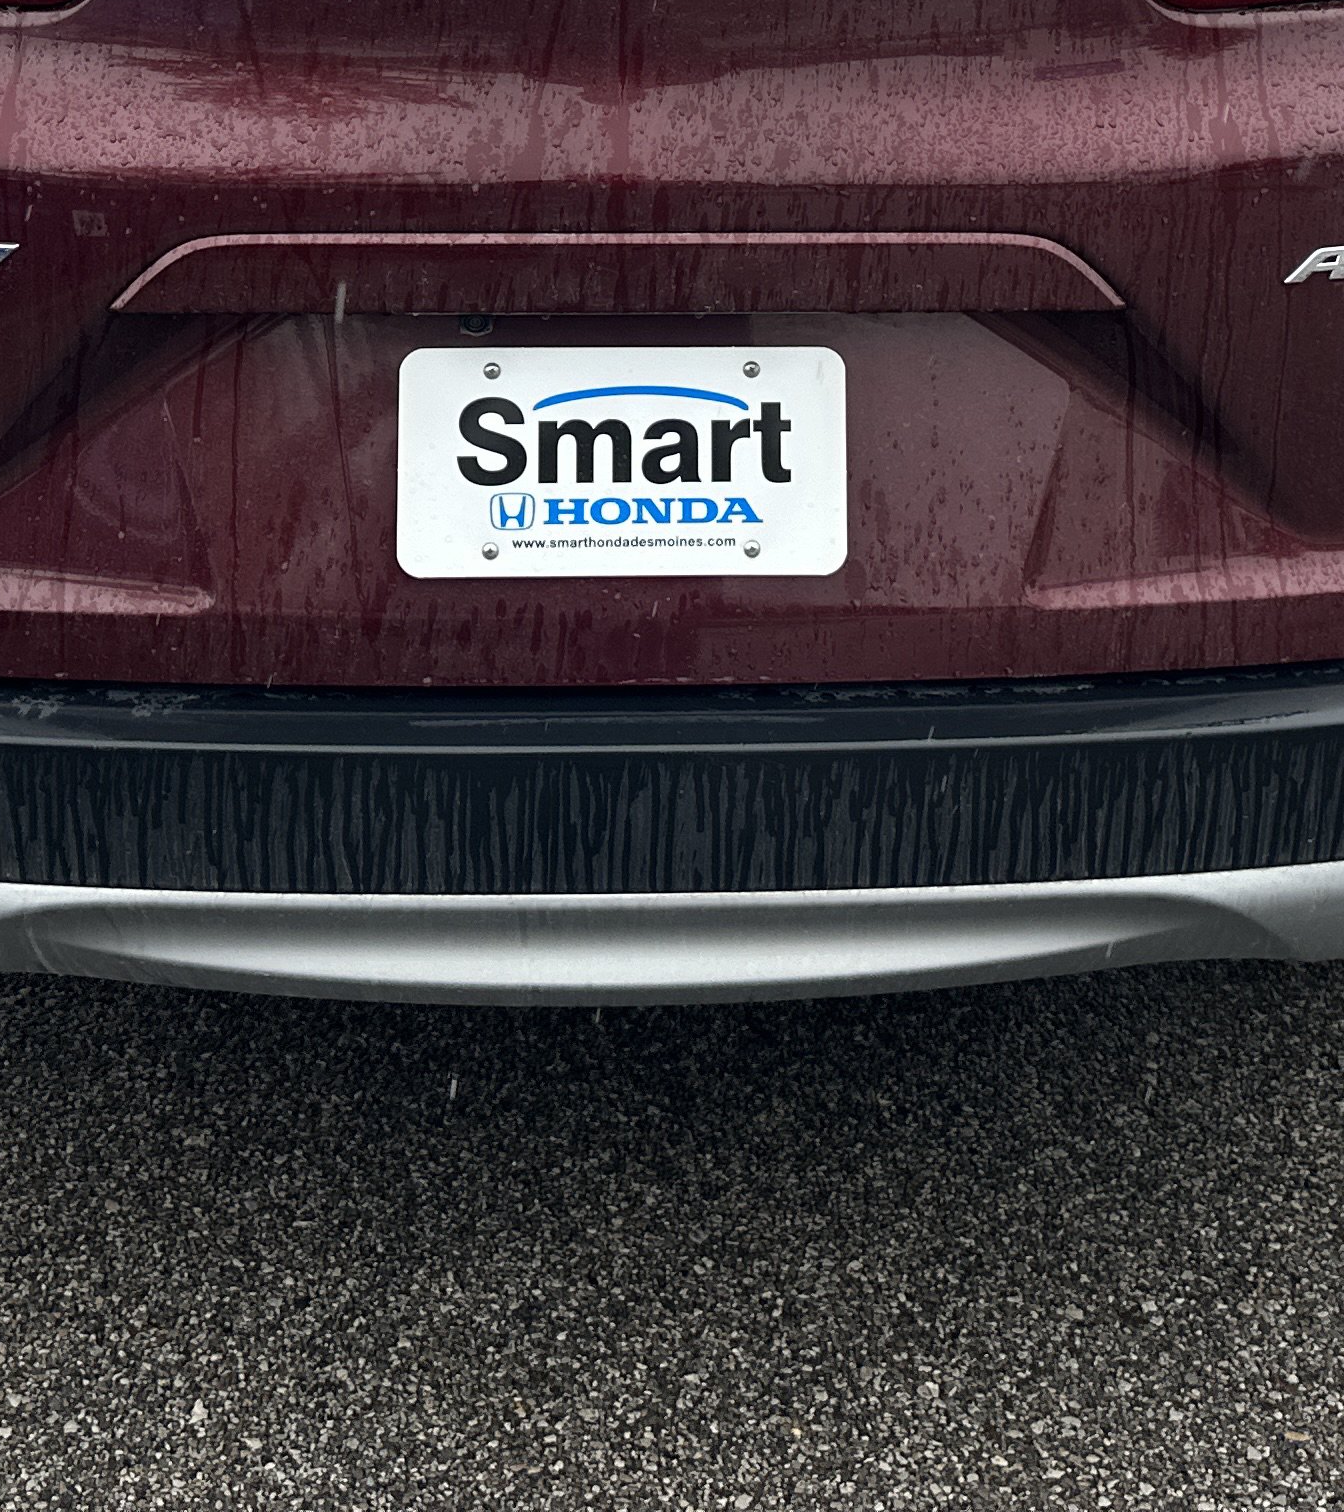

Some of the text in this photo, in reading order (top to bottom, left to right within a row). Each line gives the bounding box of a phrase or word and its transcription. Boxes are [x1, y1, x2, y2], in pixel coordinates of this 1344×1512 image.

[456, 396, 792, 486] Smart
[543, 496, 764, 524] HONDA
[511, 535, 737, 550] www.smarthondadesmoines.com
